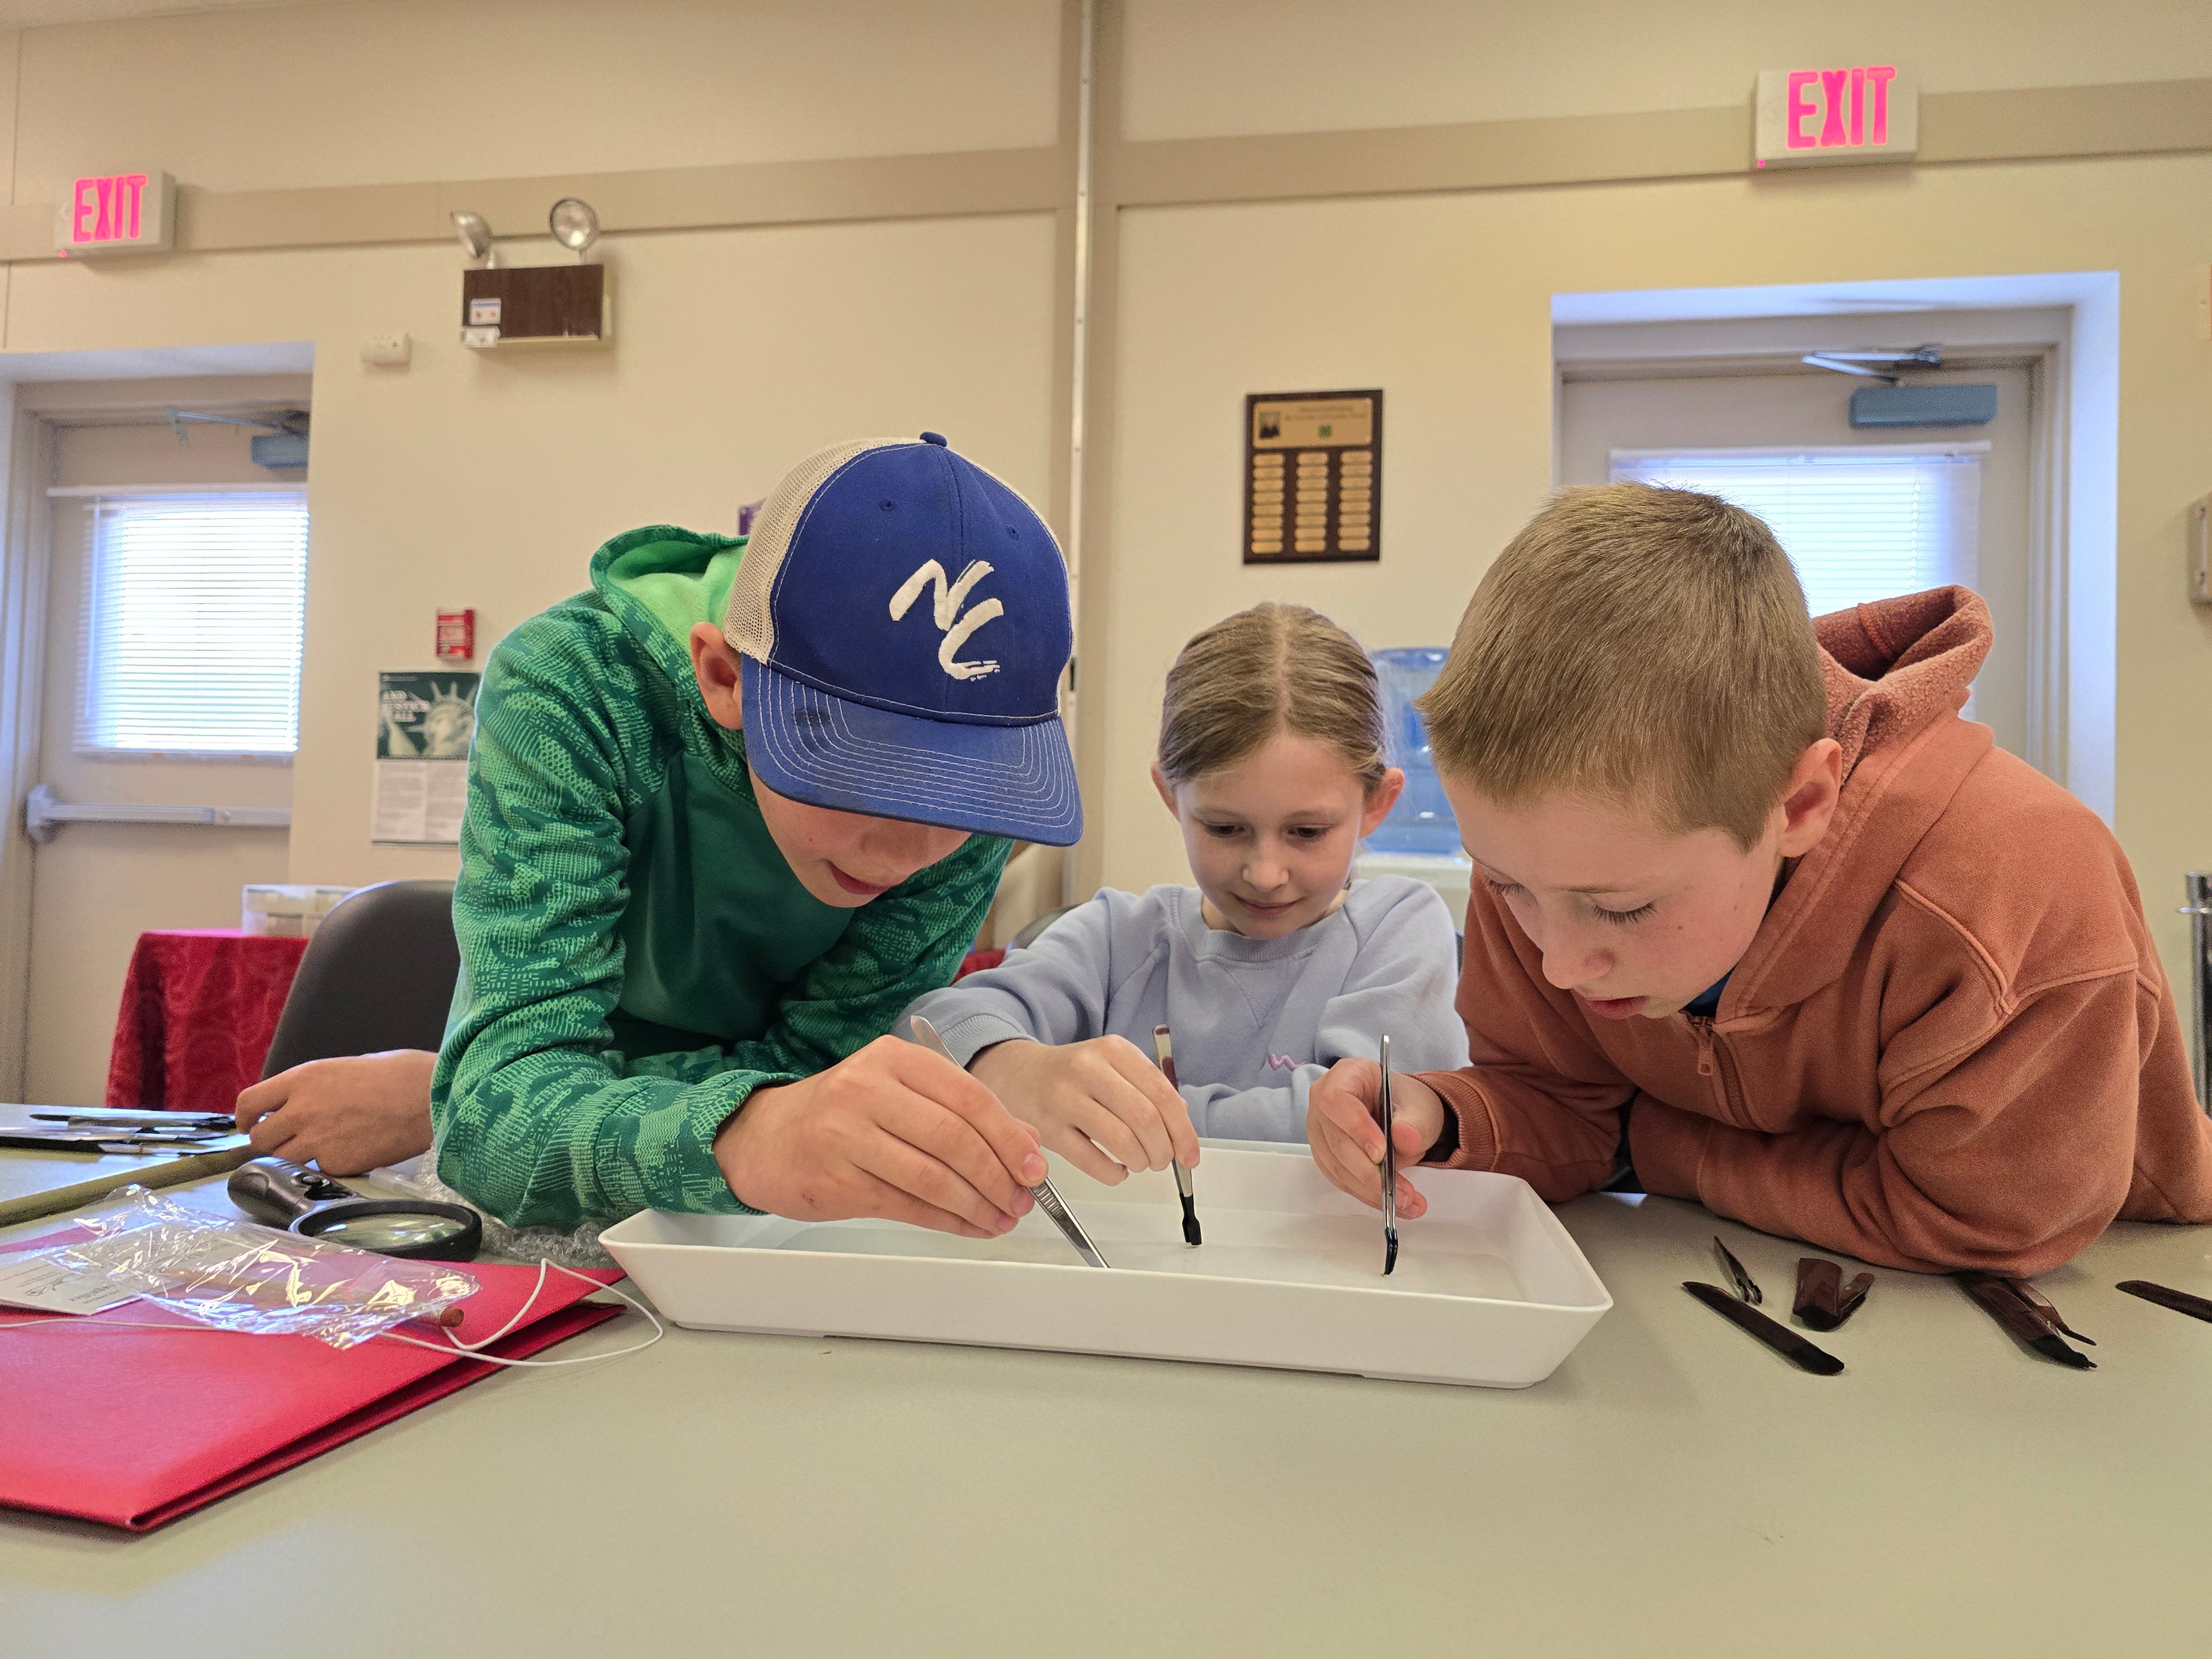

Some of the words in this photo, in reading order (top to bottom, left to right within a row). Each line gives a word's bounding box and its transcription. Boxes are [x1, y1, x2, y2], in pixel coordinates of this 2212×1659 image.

[1787, 65, 1896, 150] EXIT
[73, 173, 148, 243] EXIT
[889, 558, 1004, 681] NC
